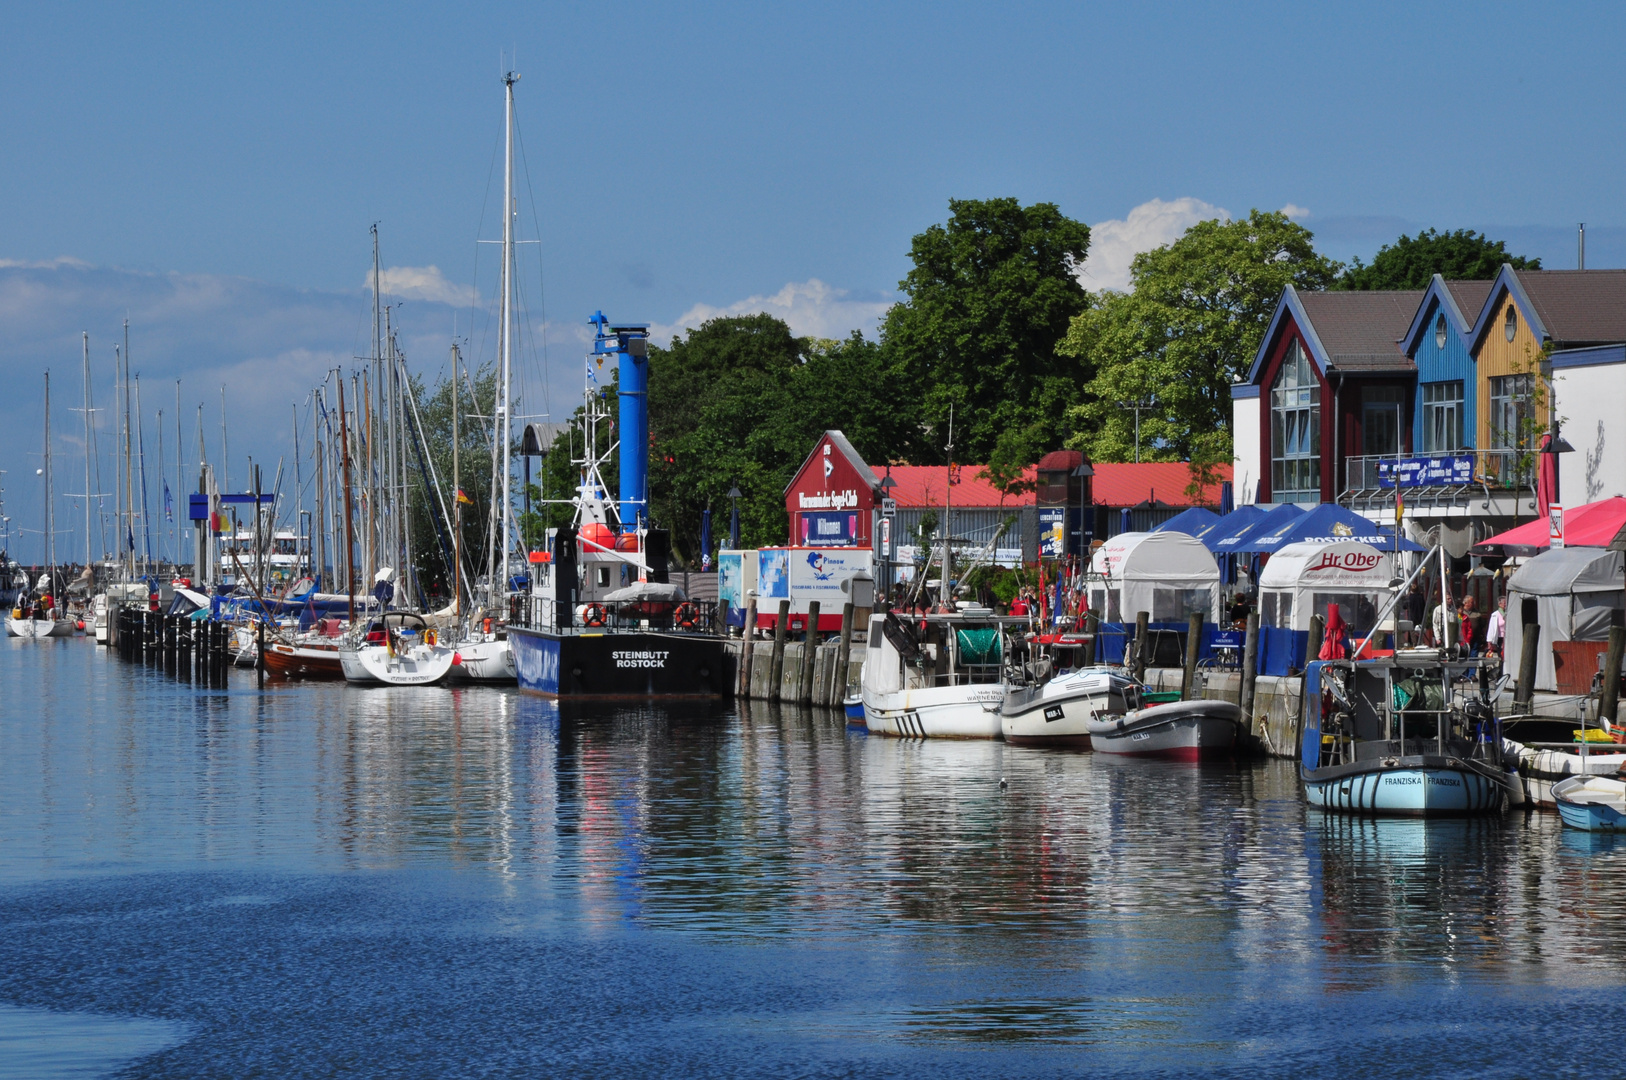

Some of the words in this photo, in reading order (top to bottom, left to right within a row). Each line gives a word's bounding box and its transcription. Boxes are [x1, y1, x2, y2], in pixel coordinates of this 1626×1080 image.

[883, 501, 895, 509] WC
[1344, 552, 1384, 567] Ober
[612, 651, 669, 659] STEINBUTT
[1427, 777, 1460, 786] FRANZISKA
